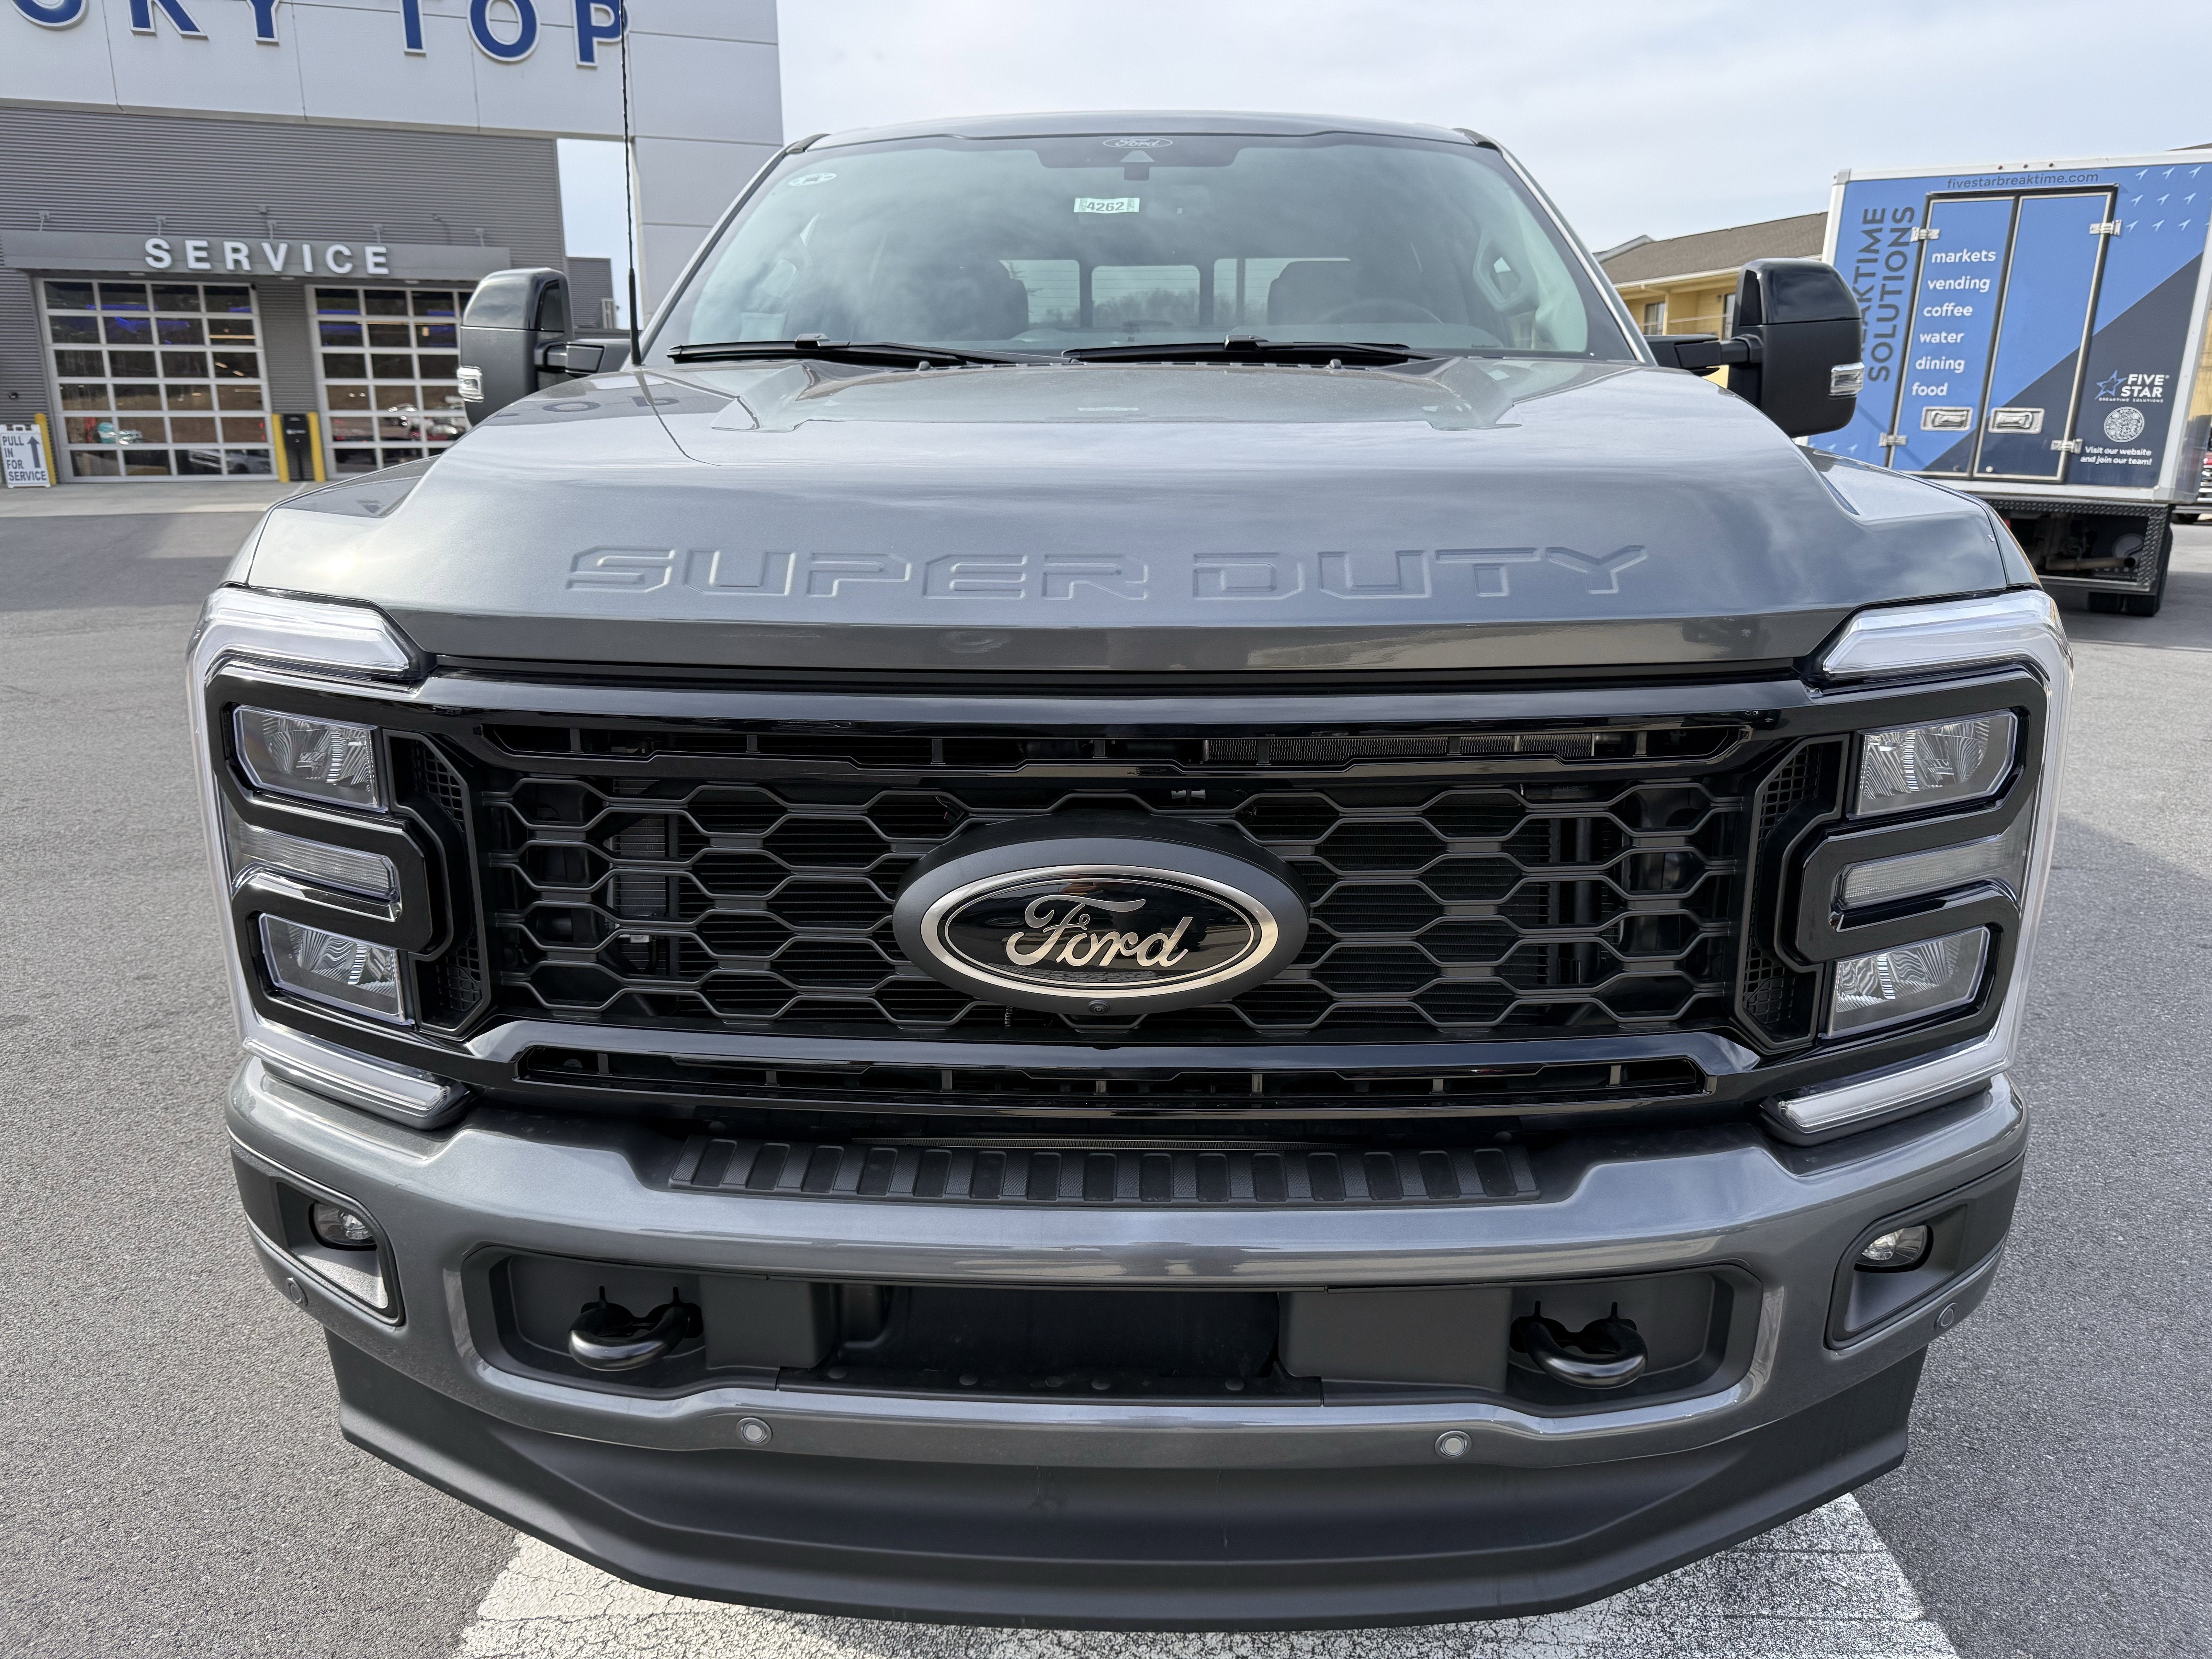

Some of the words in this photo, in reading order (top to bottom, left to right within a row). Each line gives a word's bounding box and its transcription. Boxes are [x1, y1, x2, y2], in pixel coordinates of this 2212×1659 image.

[1947, 173, 2099, 189] fivestarbreaktime.com
[1087, 201, 1125, 211] 4262
[144, 237, 389, 275] SERVICE
[1931, 248, 1996, 263] markets
[1927, 275, 1990, 293] vending
[1868, 206, 1915, 382] SOLUTIONS
[1923, 302, 1973, 317] coffee
[1919, 331, 1965, 343] water
[1915, 356, 1965, 373] dining
[2127, 374, 2165, 385] FIVE
[1911, 382, 1948, 396] food
[2121, 386, 2163, 398] STAR
[2, 436, 24, 446] PULL
[4, 448, 14, 457] IN
[6, 460, 24, 469] FOR
[2095, 456, 2112, 464] join
[9, 471, 46, 481] SERVICE
[566, 546, 1149, 601] SUPER
[1192, 545, 1649, 600] DUTY
[1005, 894, 1194, 967] Ford
